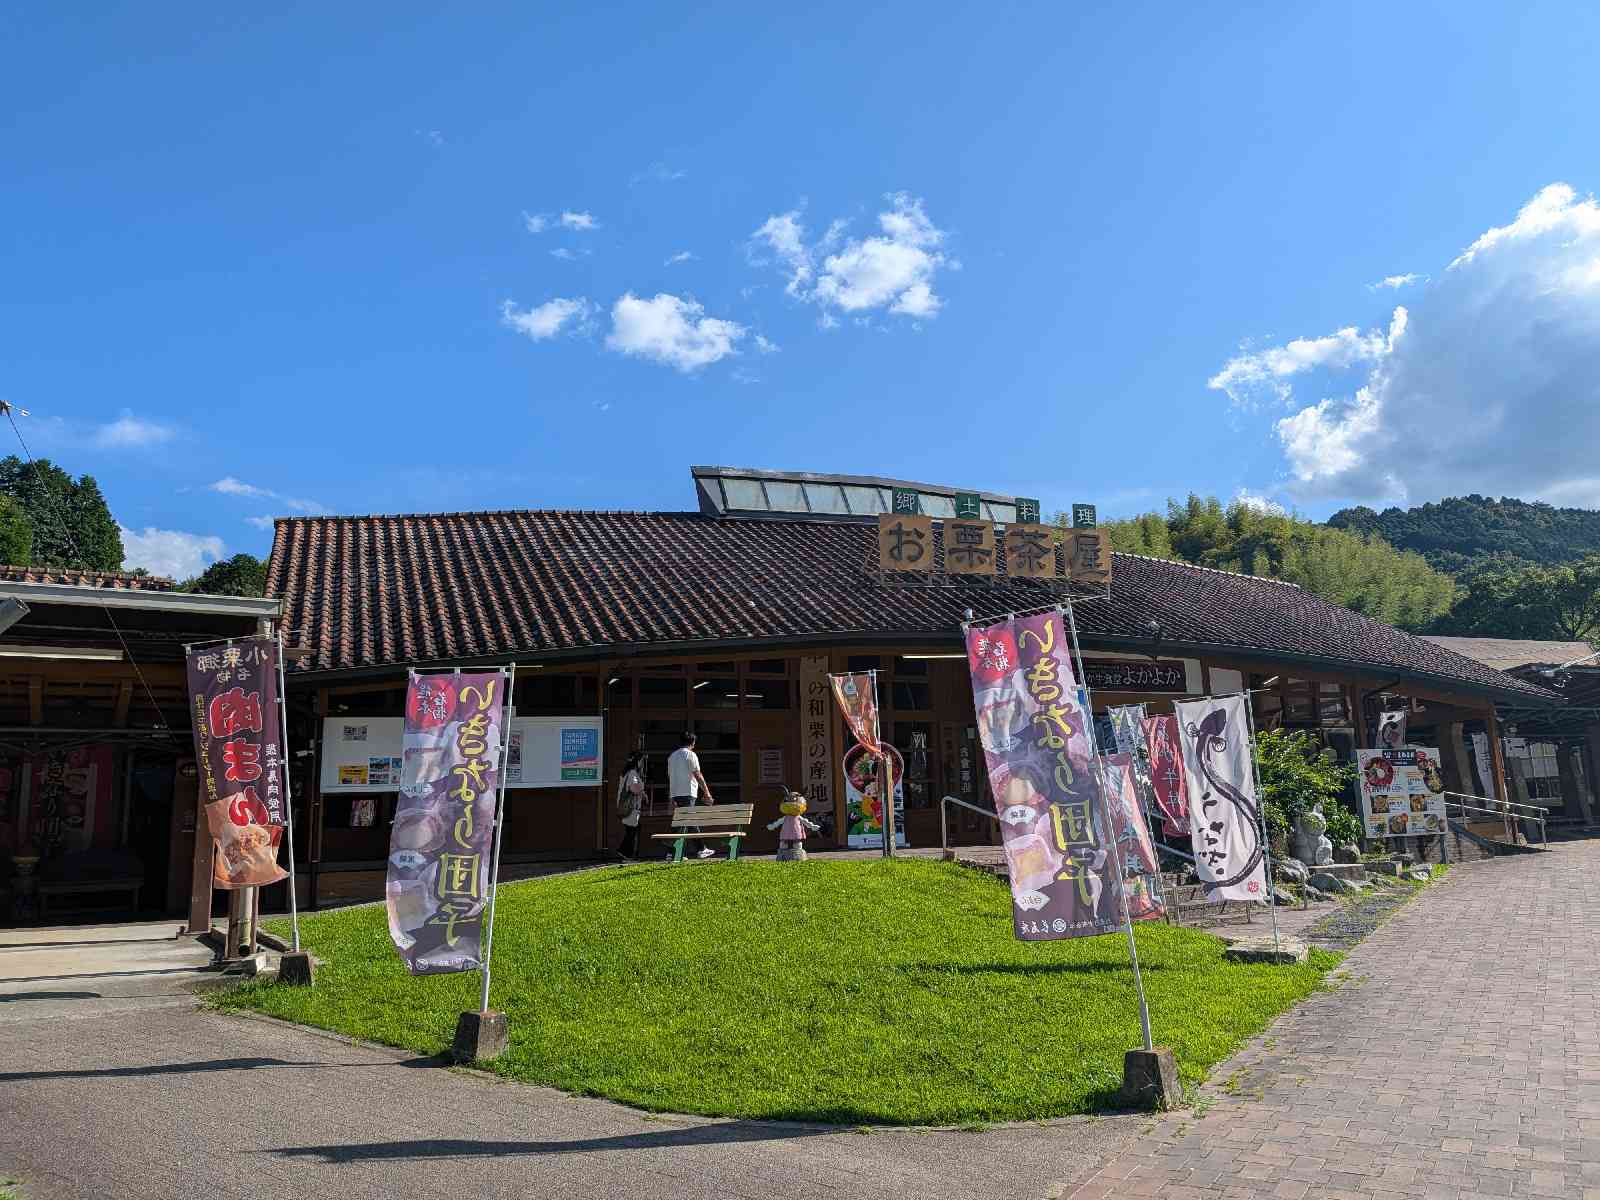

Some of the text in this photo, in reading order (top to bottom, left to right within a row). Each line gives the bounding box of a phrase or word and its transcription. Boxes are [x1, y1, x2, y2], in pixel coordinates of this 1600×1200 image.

[896, 491, 1095, 526] 郷土料理
[888, 521, 1110, 577] お栗茶屋
[806, 656, 829, 802] の和栗の産地
